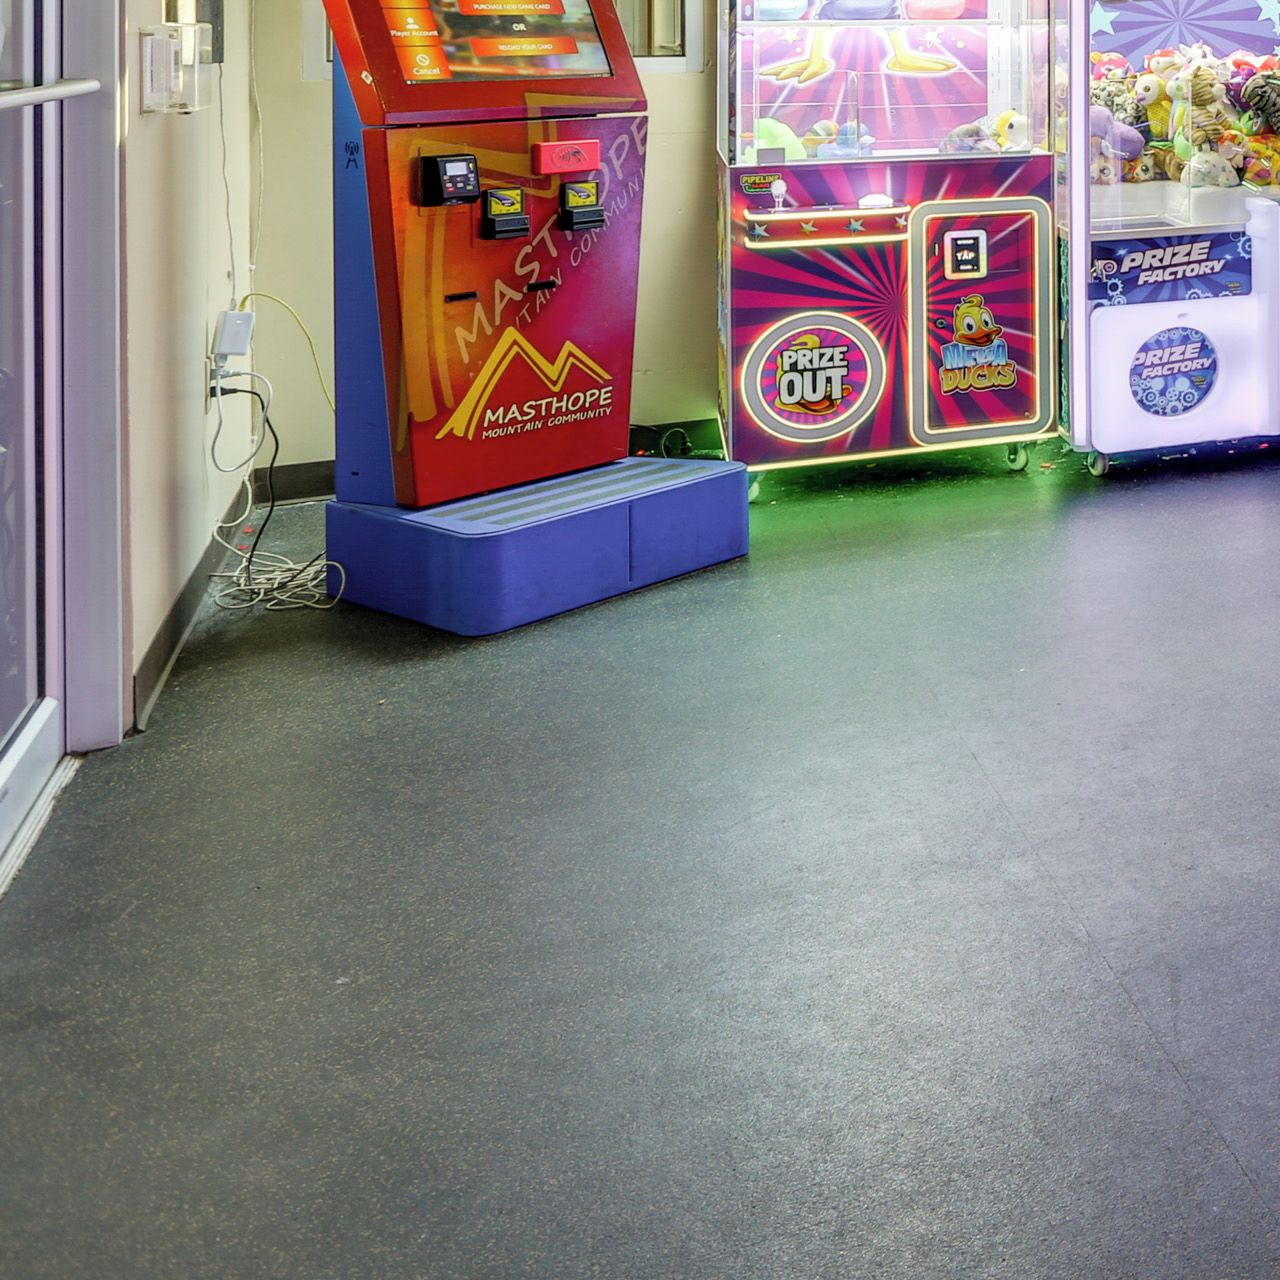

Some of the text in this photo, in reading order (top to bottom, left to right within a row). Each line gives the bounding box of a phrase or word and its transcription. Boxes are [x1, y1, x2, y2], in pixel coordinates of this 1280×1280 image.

[536, 2, 551, 10] CARD
[390, 29, 439, 38] Player Account
[512, 23, 527, 31] OR
[413, 66, 441, 75] Cancel
[955, 250, 976, 261] TAP
[1120, 240, 1212, 273] PRIZE
[1137, 259, 1226, 286] FACTORY
[781, 346, 848, 371] PRIZE
[1133, 342, 1202, 369] PRIZE
[1140, 357, 1213, 380] FACTORY
[780, 368, 848, 405] OUT
[941, 363, 1017, 394] DUCKS
[483, 386, 614, 428] MASTHOPE
[481, 406, 613, 440] MOUNTAIN COMMUNITY
